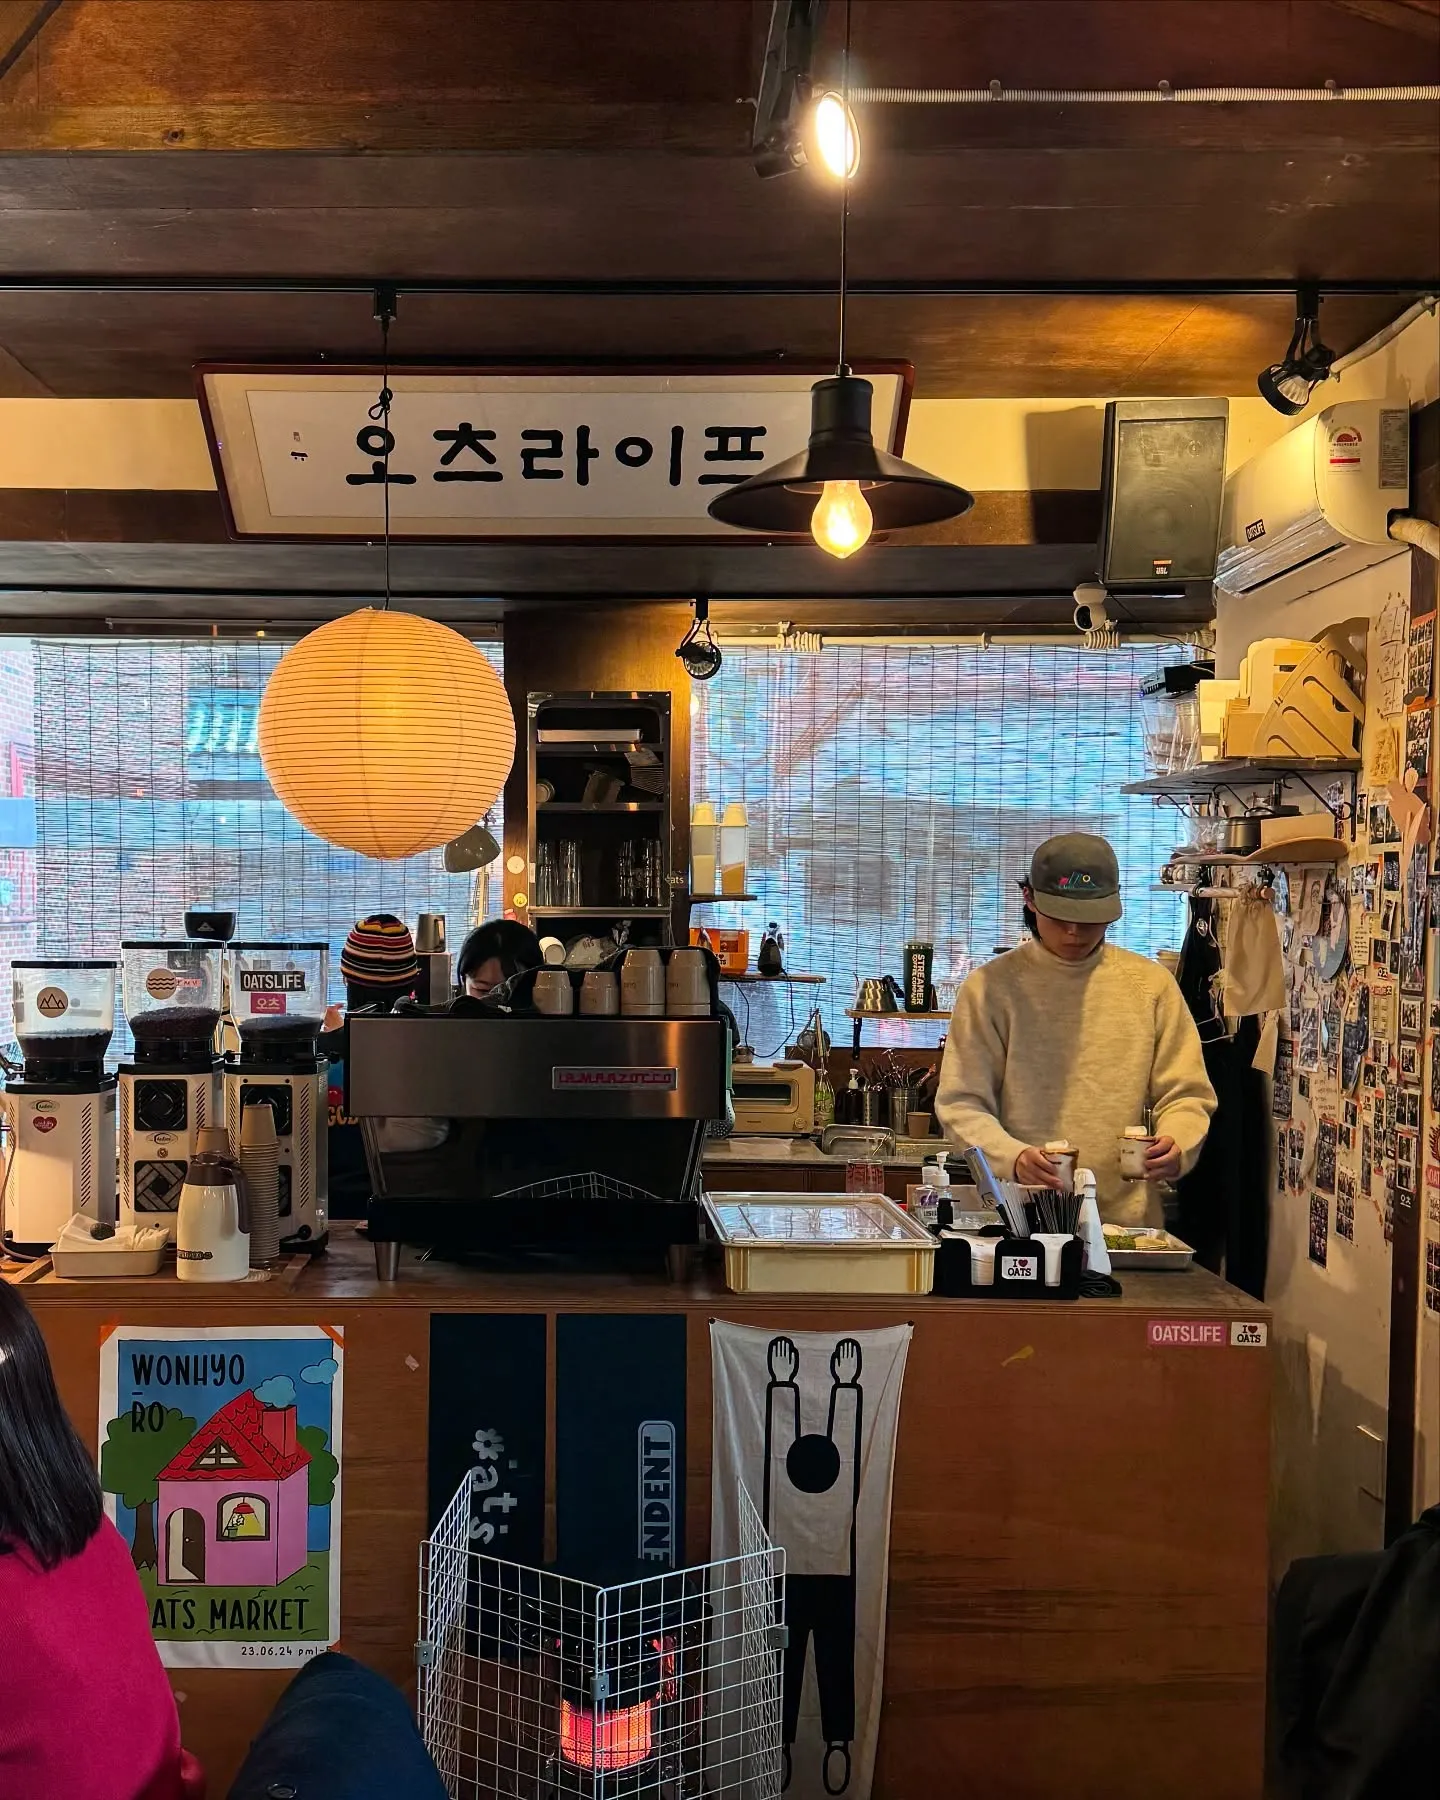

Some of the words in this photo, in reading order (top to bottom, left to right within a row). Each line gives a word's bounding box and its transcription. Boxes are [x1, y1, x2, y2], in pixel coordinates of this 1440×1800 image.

[346, 422, 767, 488] 오츠라이프
[243, 973, 303, 989] OATSLIFE
[917, 954, 925, 1005] STREAMER
[256, 997, 281, 1010] 오츠
[1012, 1258, 1018, 1268] I
[1007, 1267, 1032, 1277] OATS
[1152, 1325, 1221, 1342] OATSLIFE
[1242, 1324, 1248, 1334] I
[1237, 1333, 1261, 1343] OATS
[132, 1354, 246, 1386] WONHYO
[151, 1599, 196, 1631] ATS
[210, 1597, 310, 1631] MARKET
[241, 1646, 293, 1656] 23.06.24
